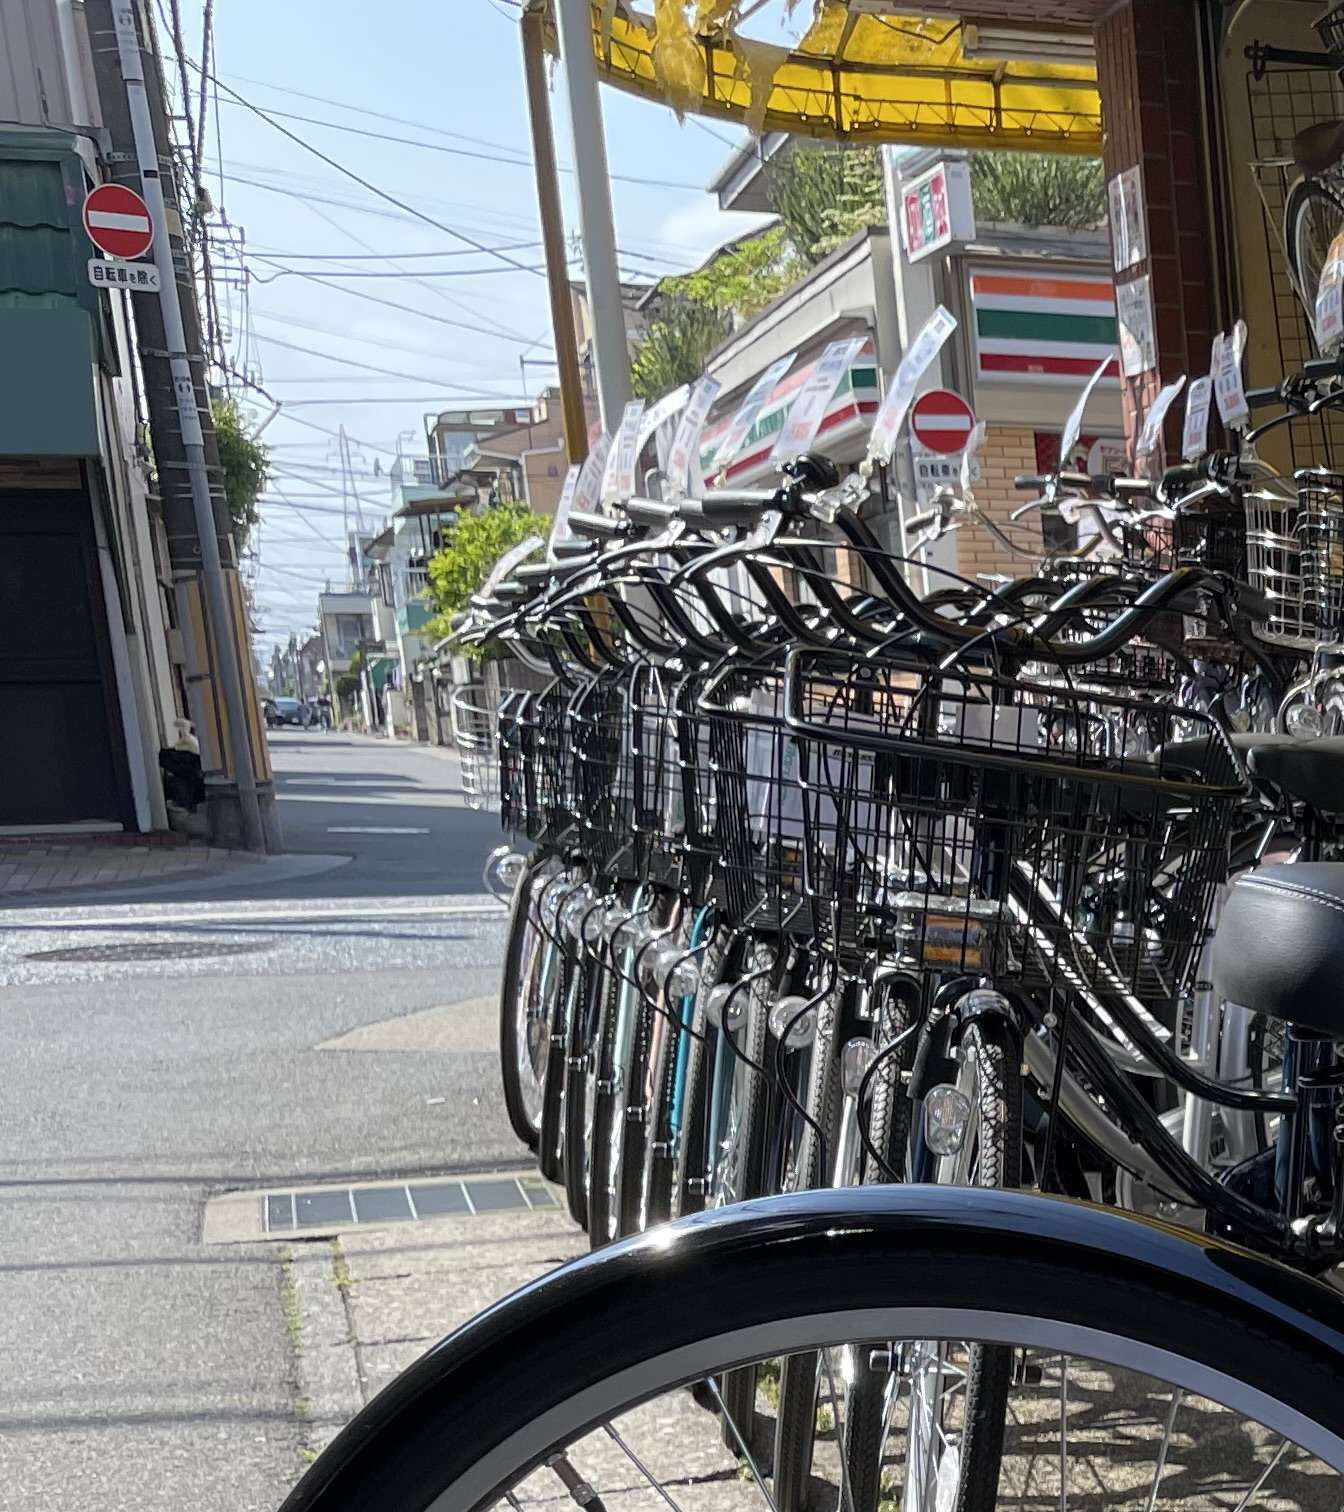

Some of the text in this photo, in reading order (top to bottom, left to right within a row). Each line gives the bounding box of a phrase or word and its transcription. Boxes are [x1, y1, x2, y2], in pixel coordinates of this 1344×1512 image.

[94, 265, 156, 285] 自転車を除く
